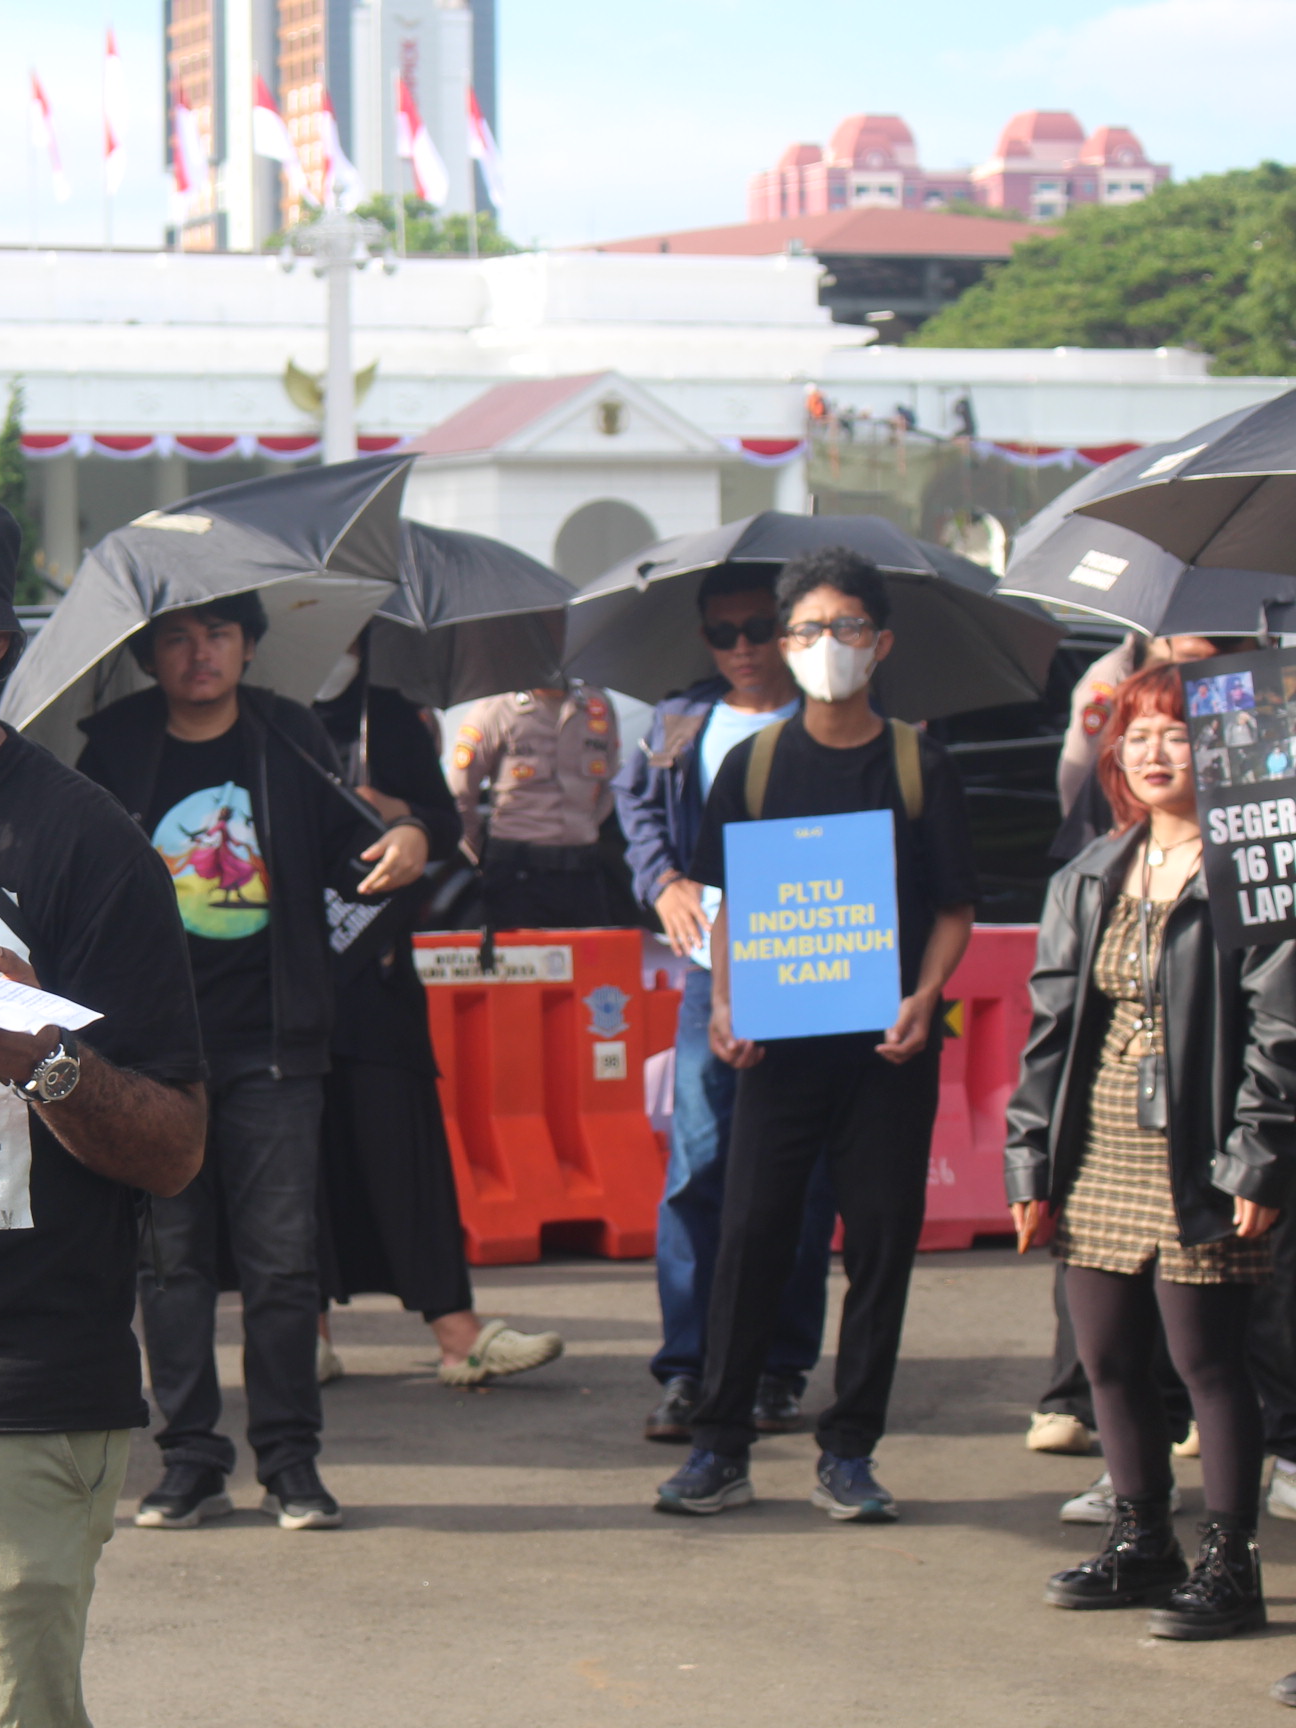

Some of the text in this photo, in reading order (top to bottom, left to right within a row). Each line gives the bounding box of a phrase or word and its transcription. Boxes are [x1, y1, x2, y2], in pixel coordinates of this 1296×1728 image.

[1232, 844, 1269, 884] 16
[778, 879, 843, 904] PLTU
[749, 904, 875, 933] INDUSTRI
[733, 929, 894, 961] MEMBUNUH
[778, 959, 850, 985] KAMI
